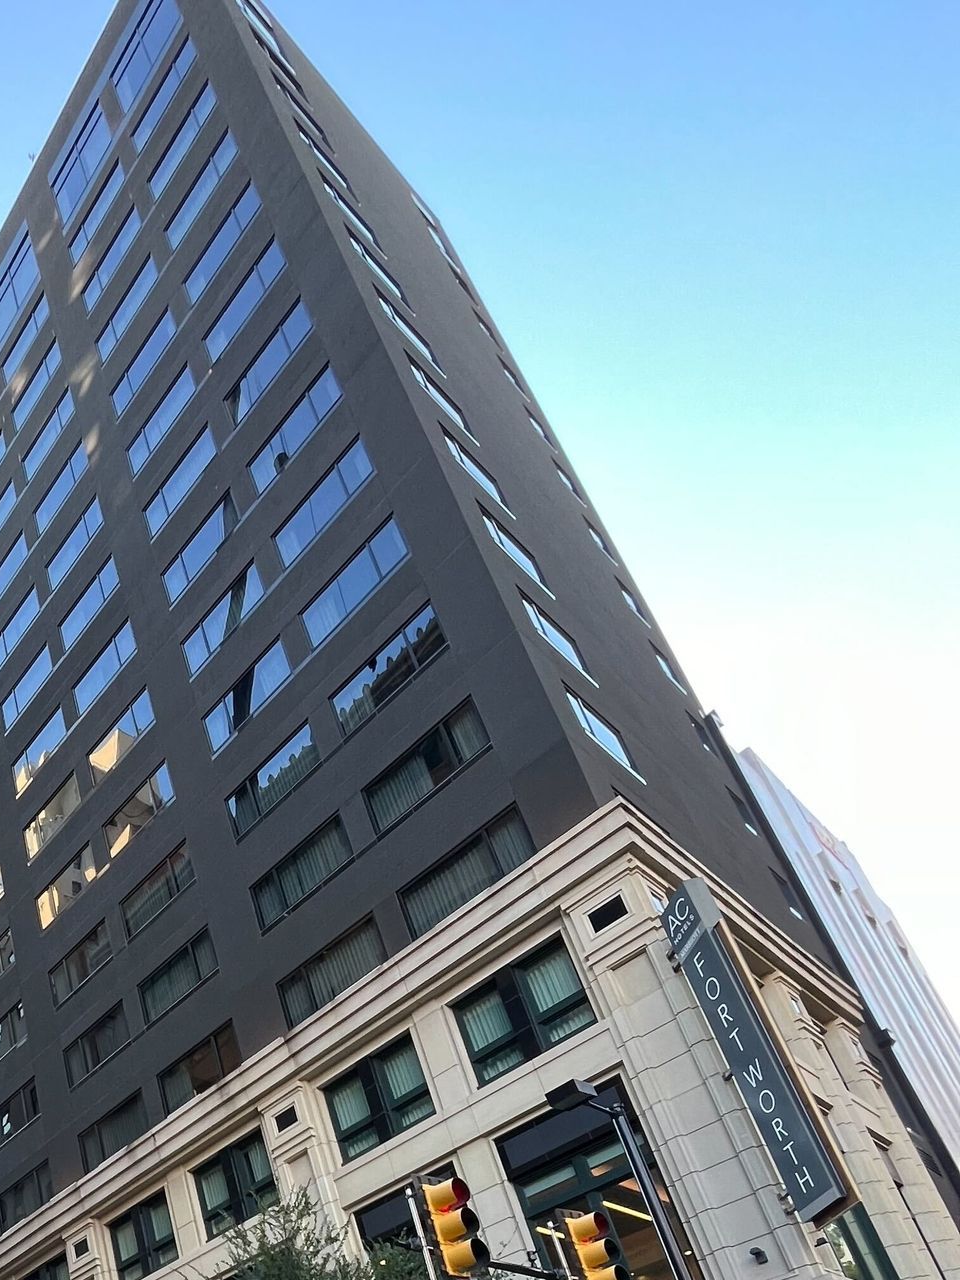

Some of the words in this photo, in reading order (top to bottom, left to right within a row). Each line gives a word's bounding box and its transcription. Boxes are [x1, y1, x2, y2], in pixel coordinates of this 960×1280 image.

[668, 897, 689, 938] AC
[674, 914, 695, 946] HOTELS
[693, 951, 744, 1052] FORT
[742, 1058, 816, 1194] WORTH
